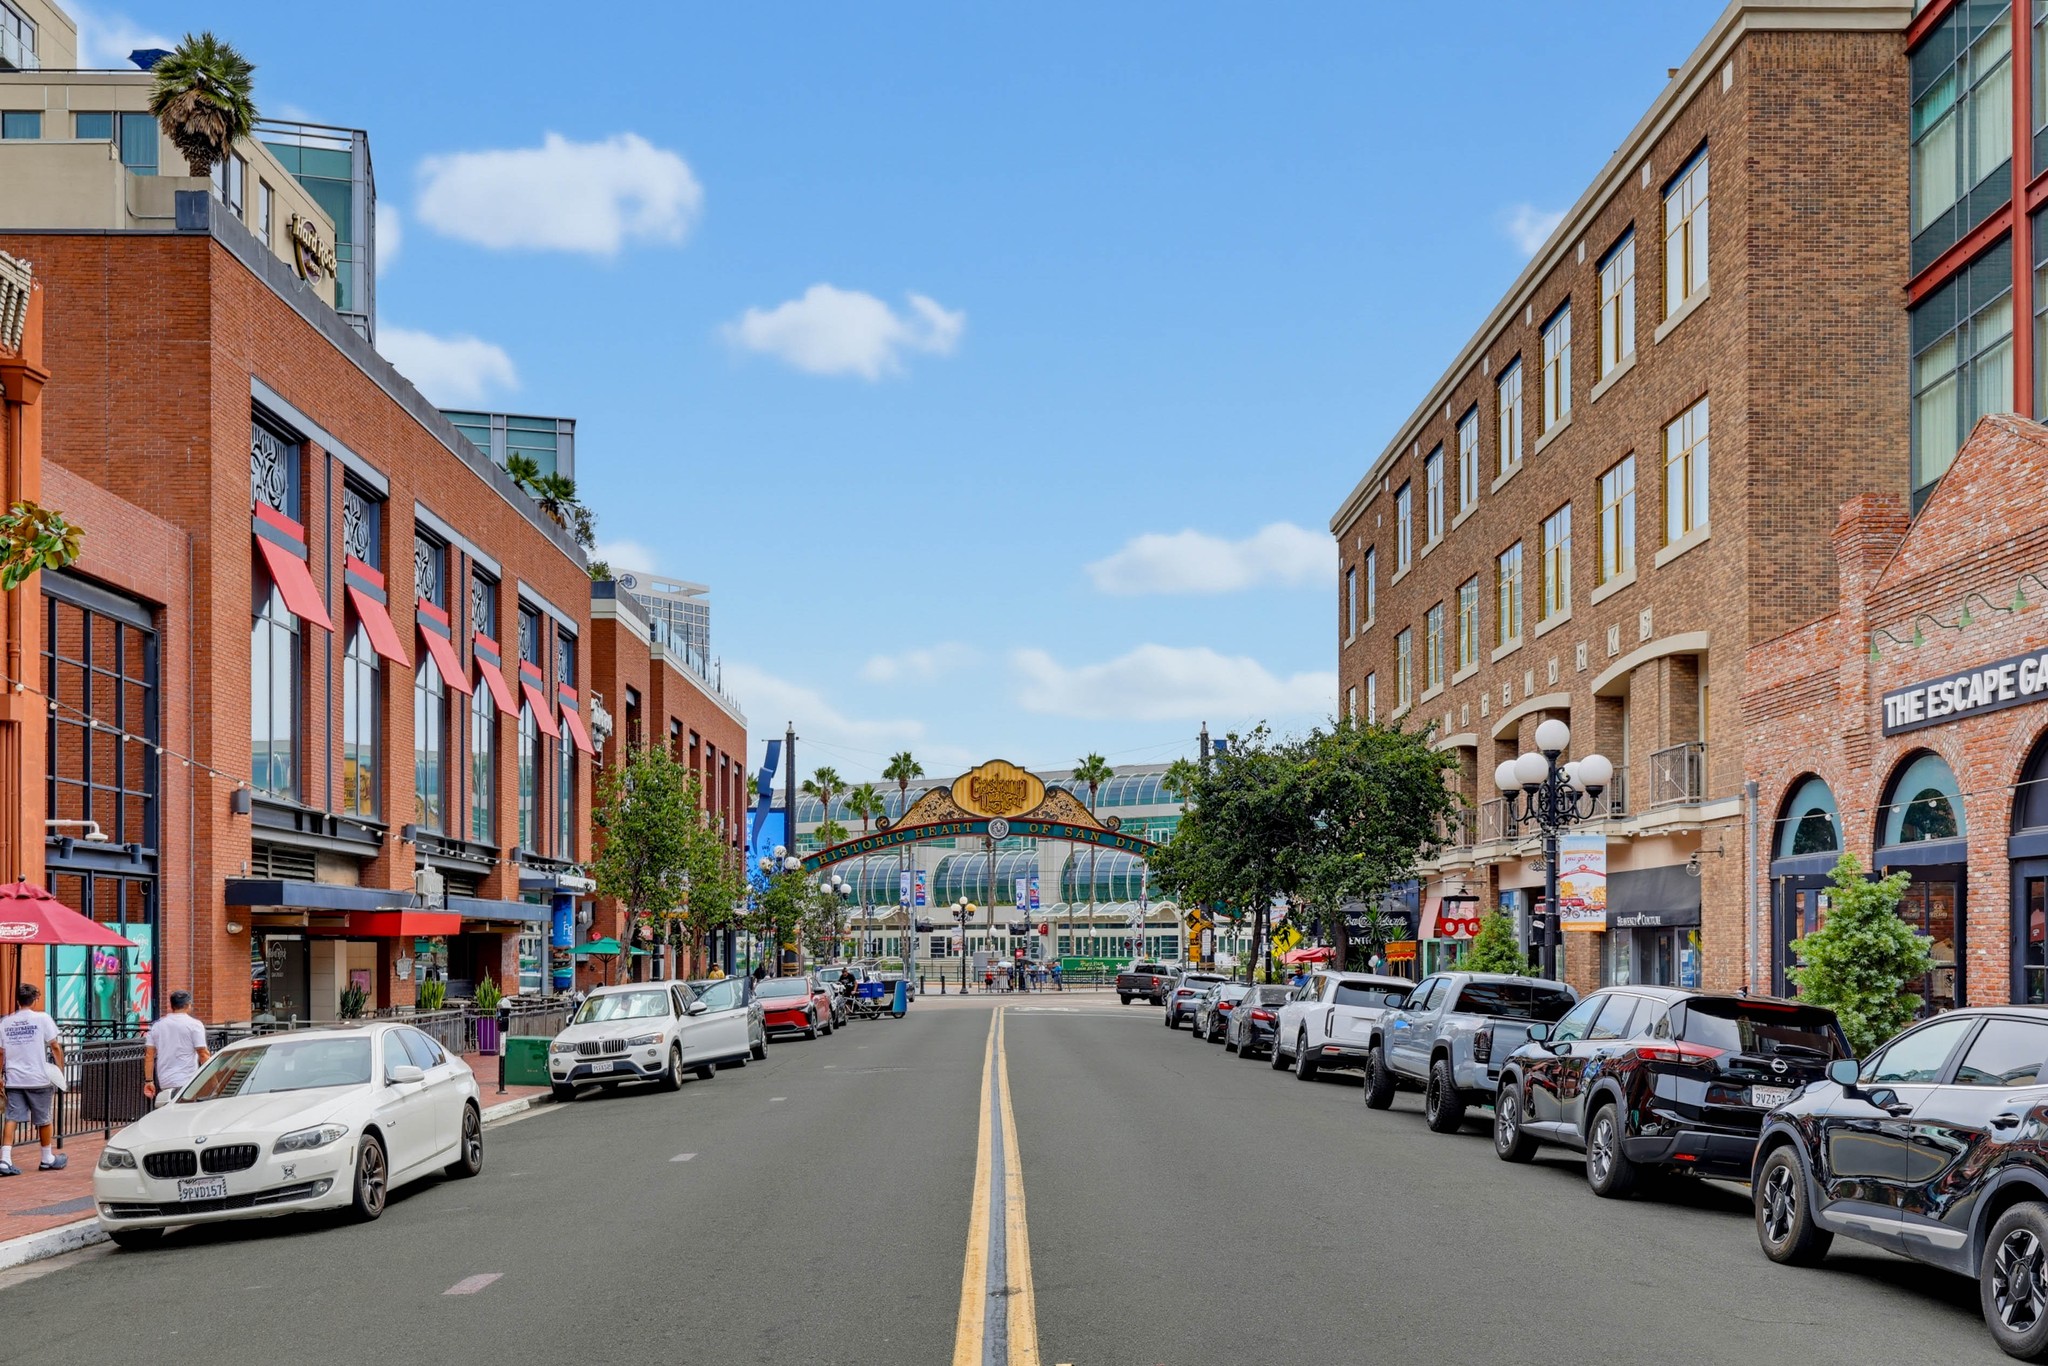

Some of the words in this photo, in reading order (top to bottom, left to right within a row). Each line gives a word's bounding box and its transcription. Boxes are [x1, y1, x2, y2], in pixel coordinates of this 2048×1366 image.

[295, 214, 318, 253] Hard
[318, 238, 337, 278] Rock
[1884, 688, 1926, 728] THE
[1927, 663, 2017, 718] ESCAPE
[817, 831, 905, 865] HISTORIC
[915, 822, 974, 838] HEART
[1029, 823, 1052, 834] OF
[1064, 826, 1102, 842] SAN
[1747, 1074, 1807, 1085] ROGUE
[182, 1184, 223, 1200] 9PVD157
